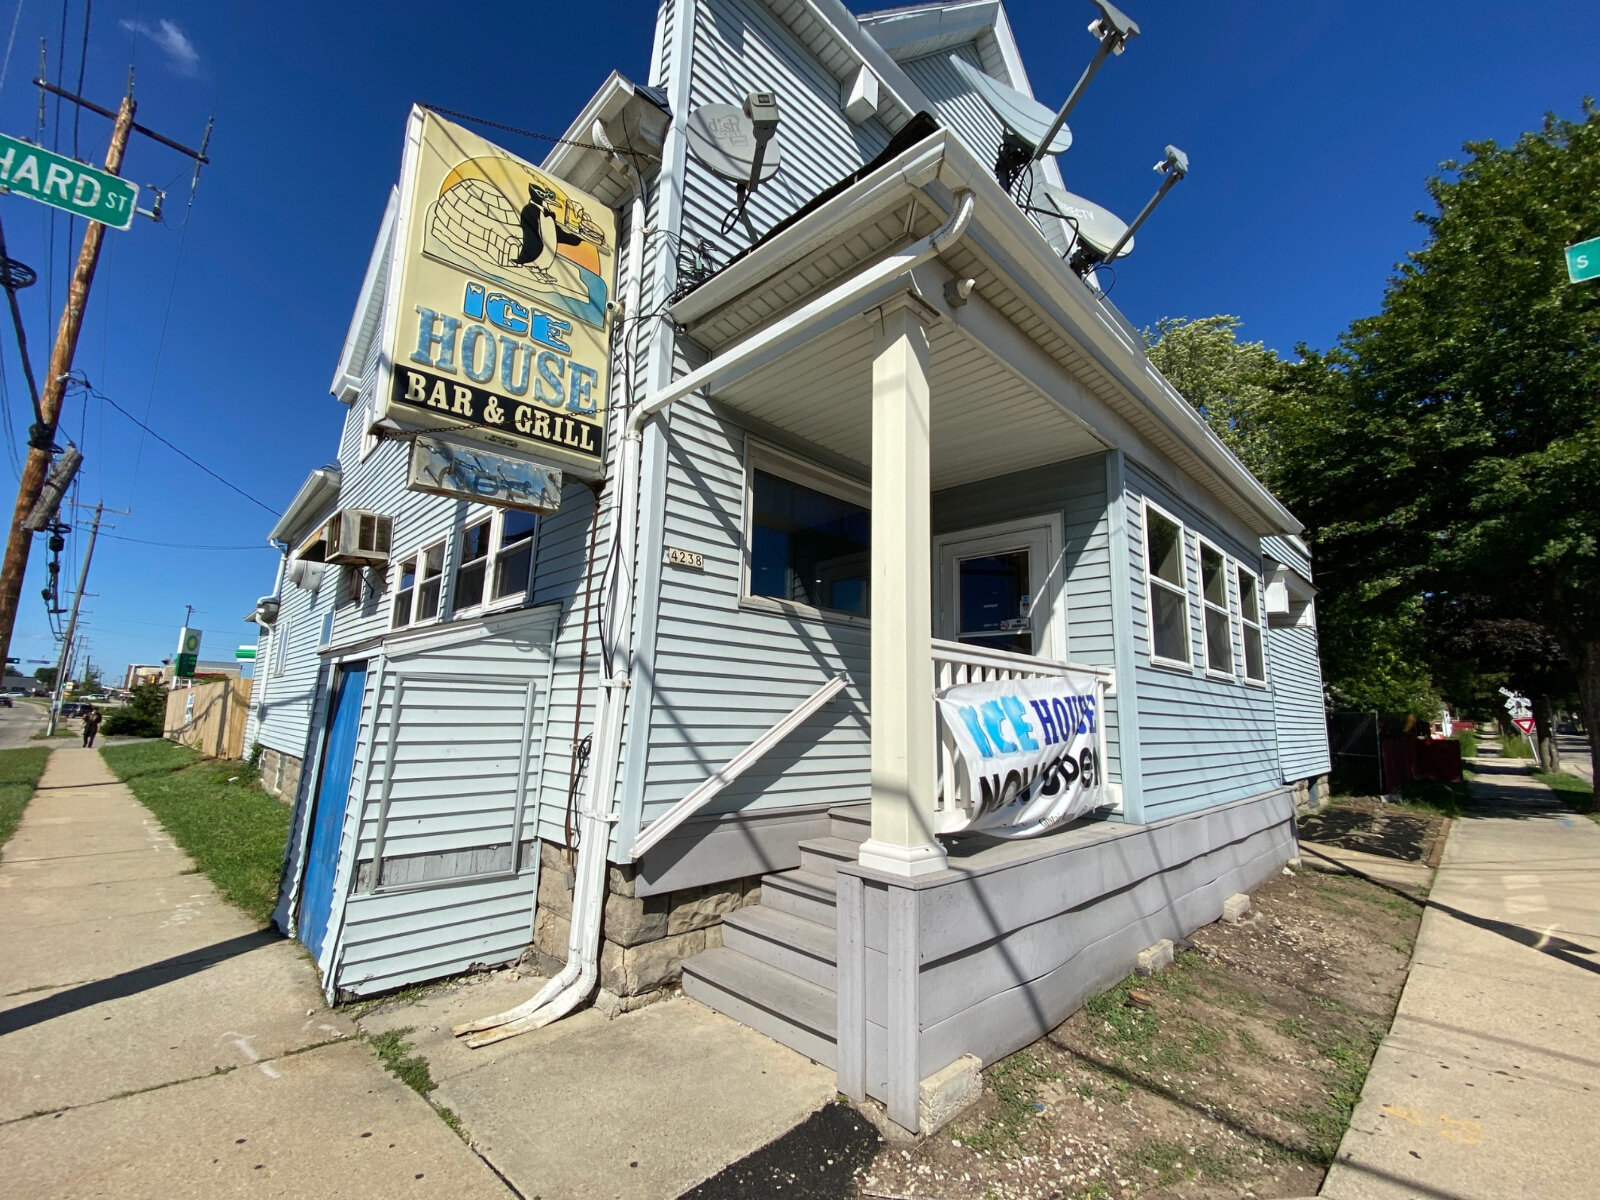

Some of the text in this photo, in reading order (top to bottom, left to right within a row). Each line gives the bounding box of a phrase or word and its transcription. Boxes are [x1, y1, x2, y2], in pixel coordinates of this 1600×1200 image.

[105, 192, 127, 211] ST
[1576, 254, 1589, 269] S
[462, 281, 571, 353] ICE
[409, 304, 599, 420] HOUSE
[404, 371, 594, 451] BAR & GRILL
[671, 550, 702, 567] 4238
[959, 695, 1096, 758] ICE HOUSE
